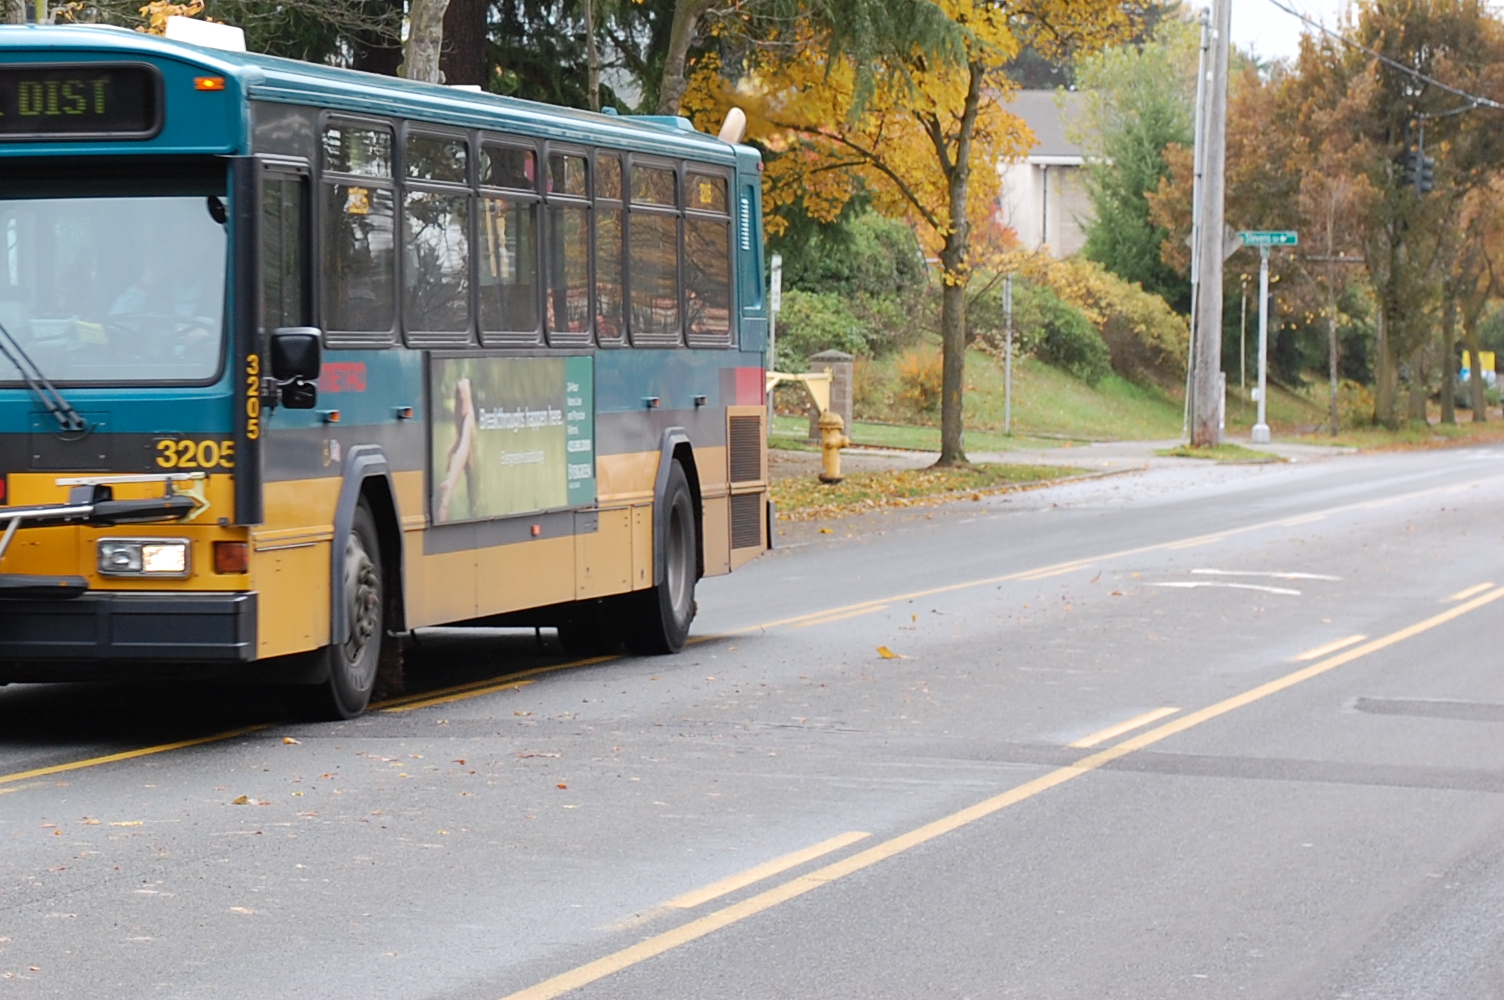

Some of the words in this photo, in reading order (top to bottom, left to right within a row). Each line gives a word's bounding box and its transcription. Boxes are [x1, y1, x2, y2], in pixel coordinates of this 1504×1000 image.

[18, 80, 109, 116] DIST
[246, 354, 260, 440] 3205
[479, 407, 525, 433] Breakthroughs
[156, 439, 235, 468] 3205
